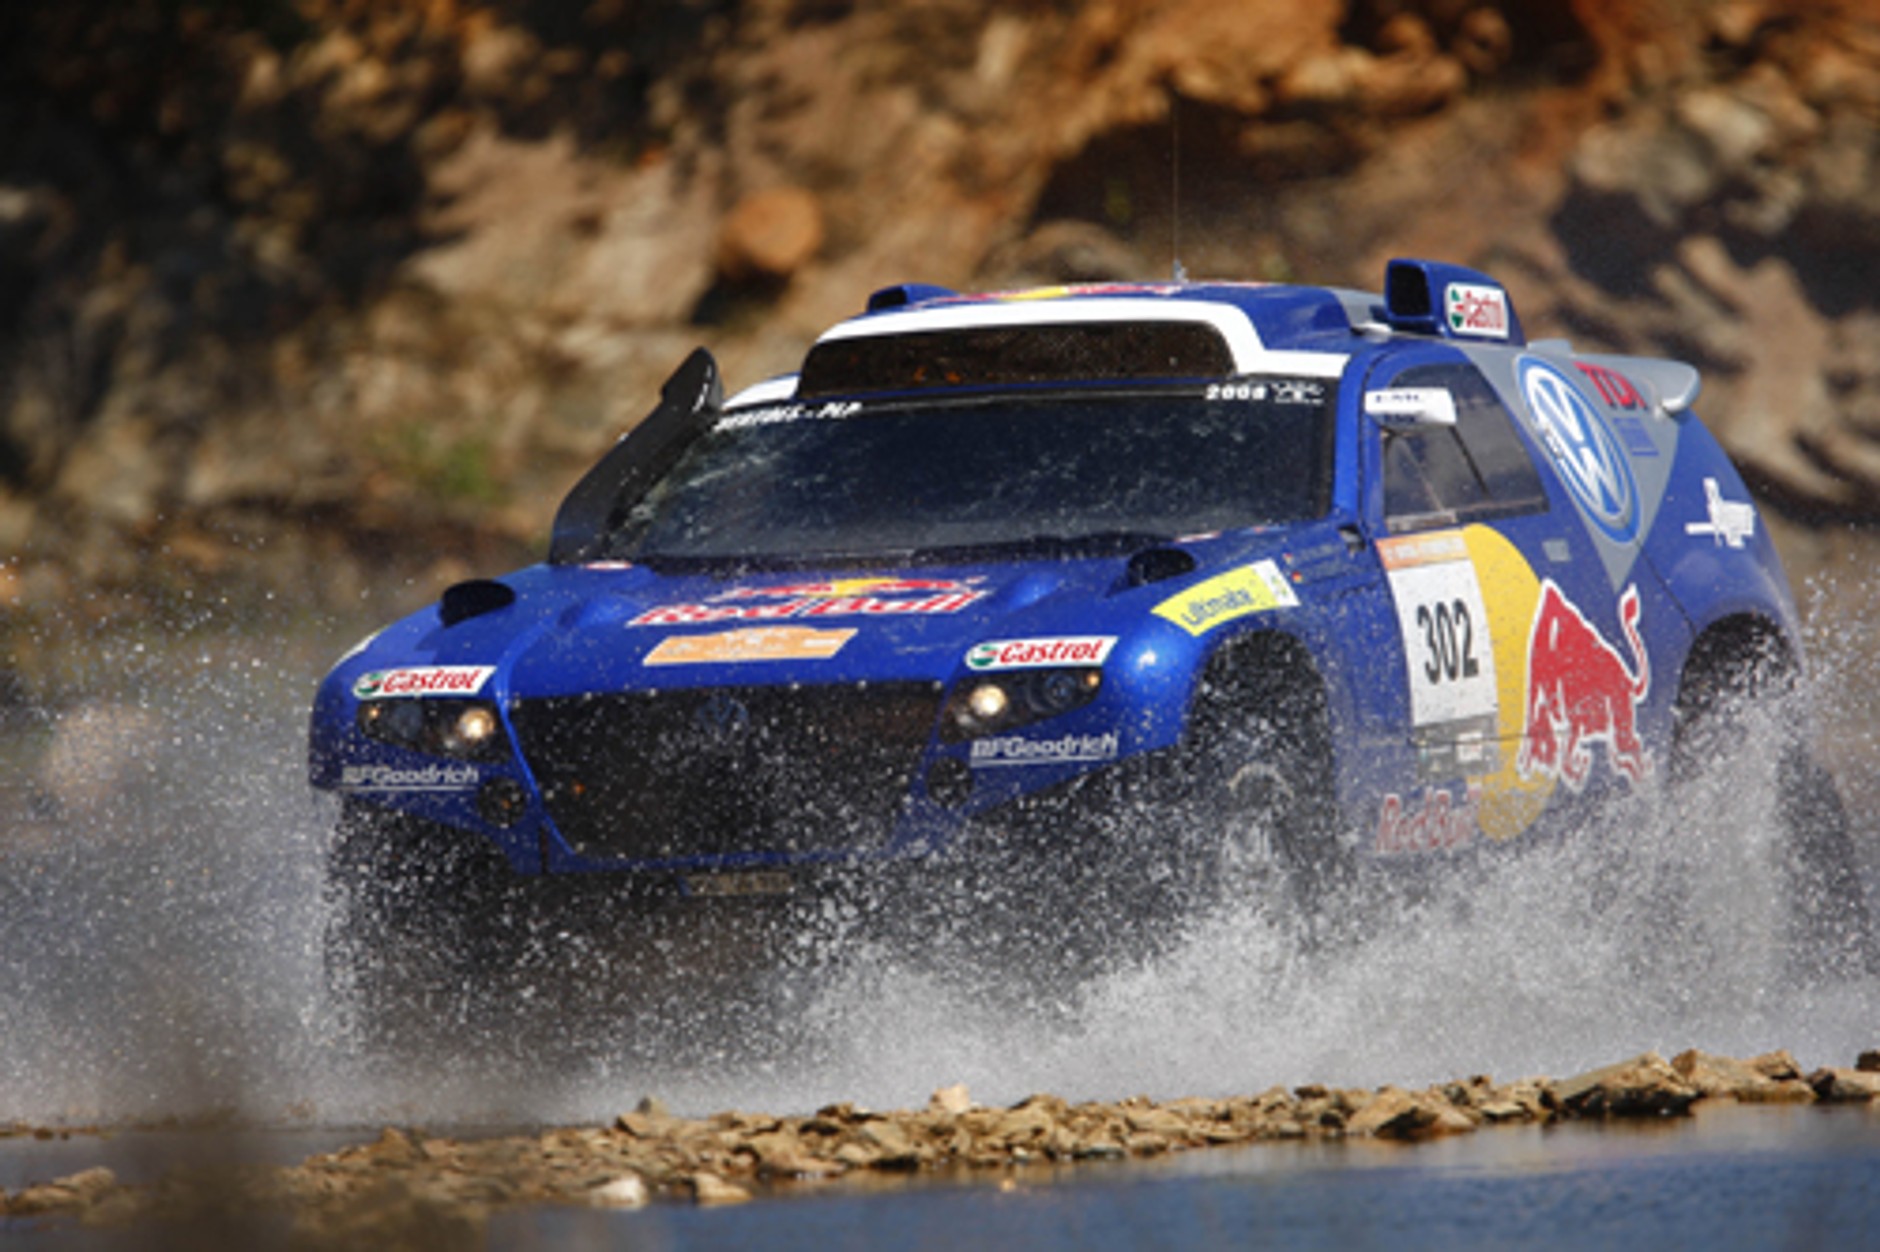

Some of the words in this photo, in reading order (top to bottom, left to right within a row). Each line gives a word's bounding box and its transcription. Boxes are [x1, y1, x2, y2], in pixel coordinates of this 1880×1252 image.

[626, 599, 810, 627] Red
[800, 591, 990, 617] Bull
[1000, 639, 1104, 664] Castrol
[1416, 598, 1479, 685] 302
[383, 668, 482, 693] Castrol
[968, 731, 1119, 760] BFGoodrich
